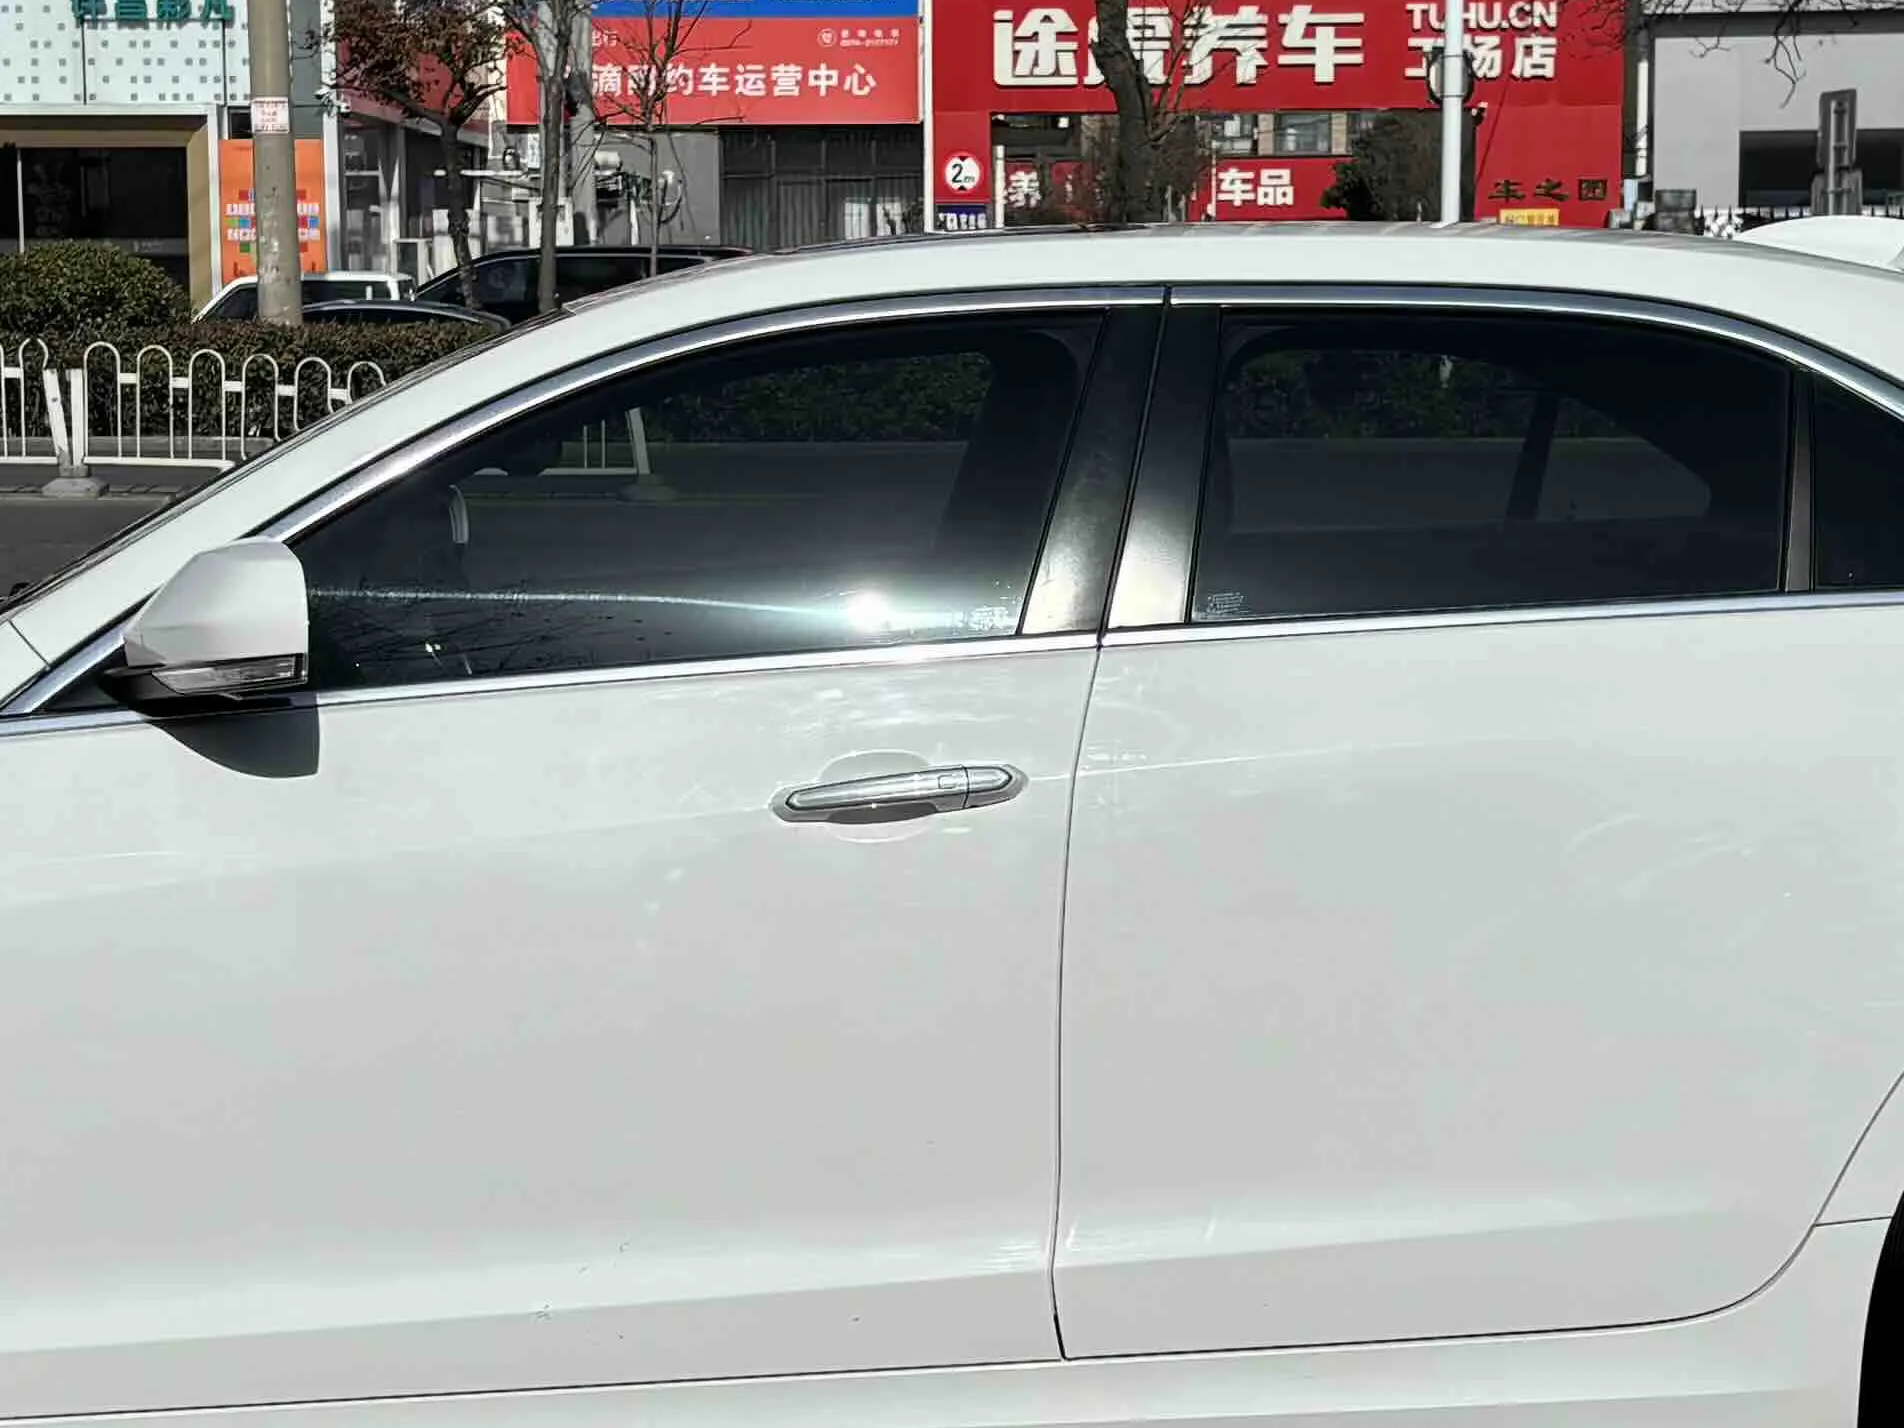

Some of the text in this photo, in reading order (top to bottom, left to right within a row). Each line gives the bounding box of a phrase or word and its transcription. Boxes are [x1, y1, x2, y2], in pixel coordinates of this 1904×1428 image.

[1405, 1, 1558, 30] TUHU.CN
[992, 5, 1365, 87] 途虎养车
[564, 61, 877, 98] 滴网约车运营中心
[1217, 168, 1294, 207] 车品
